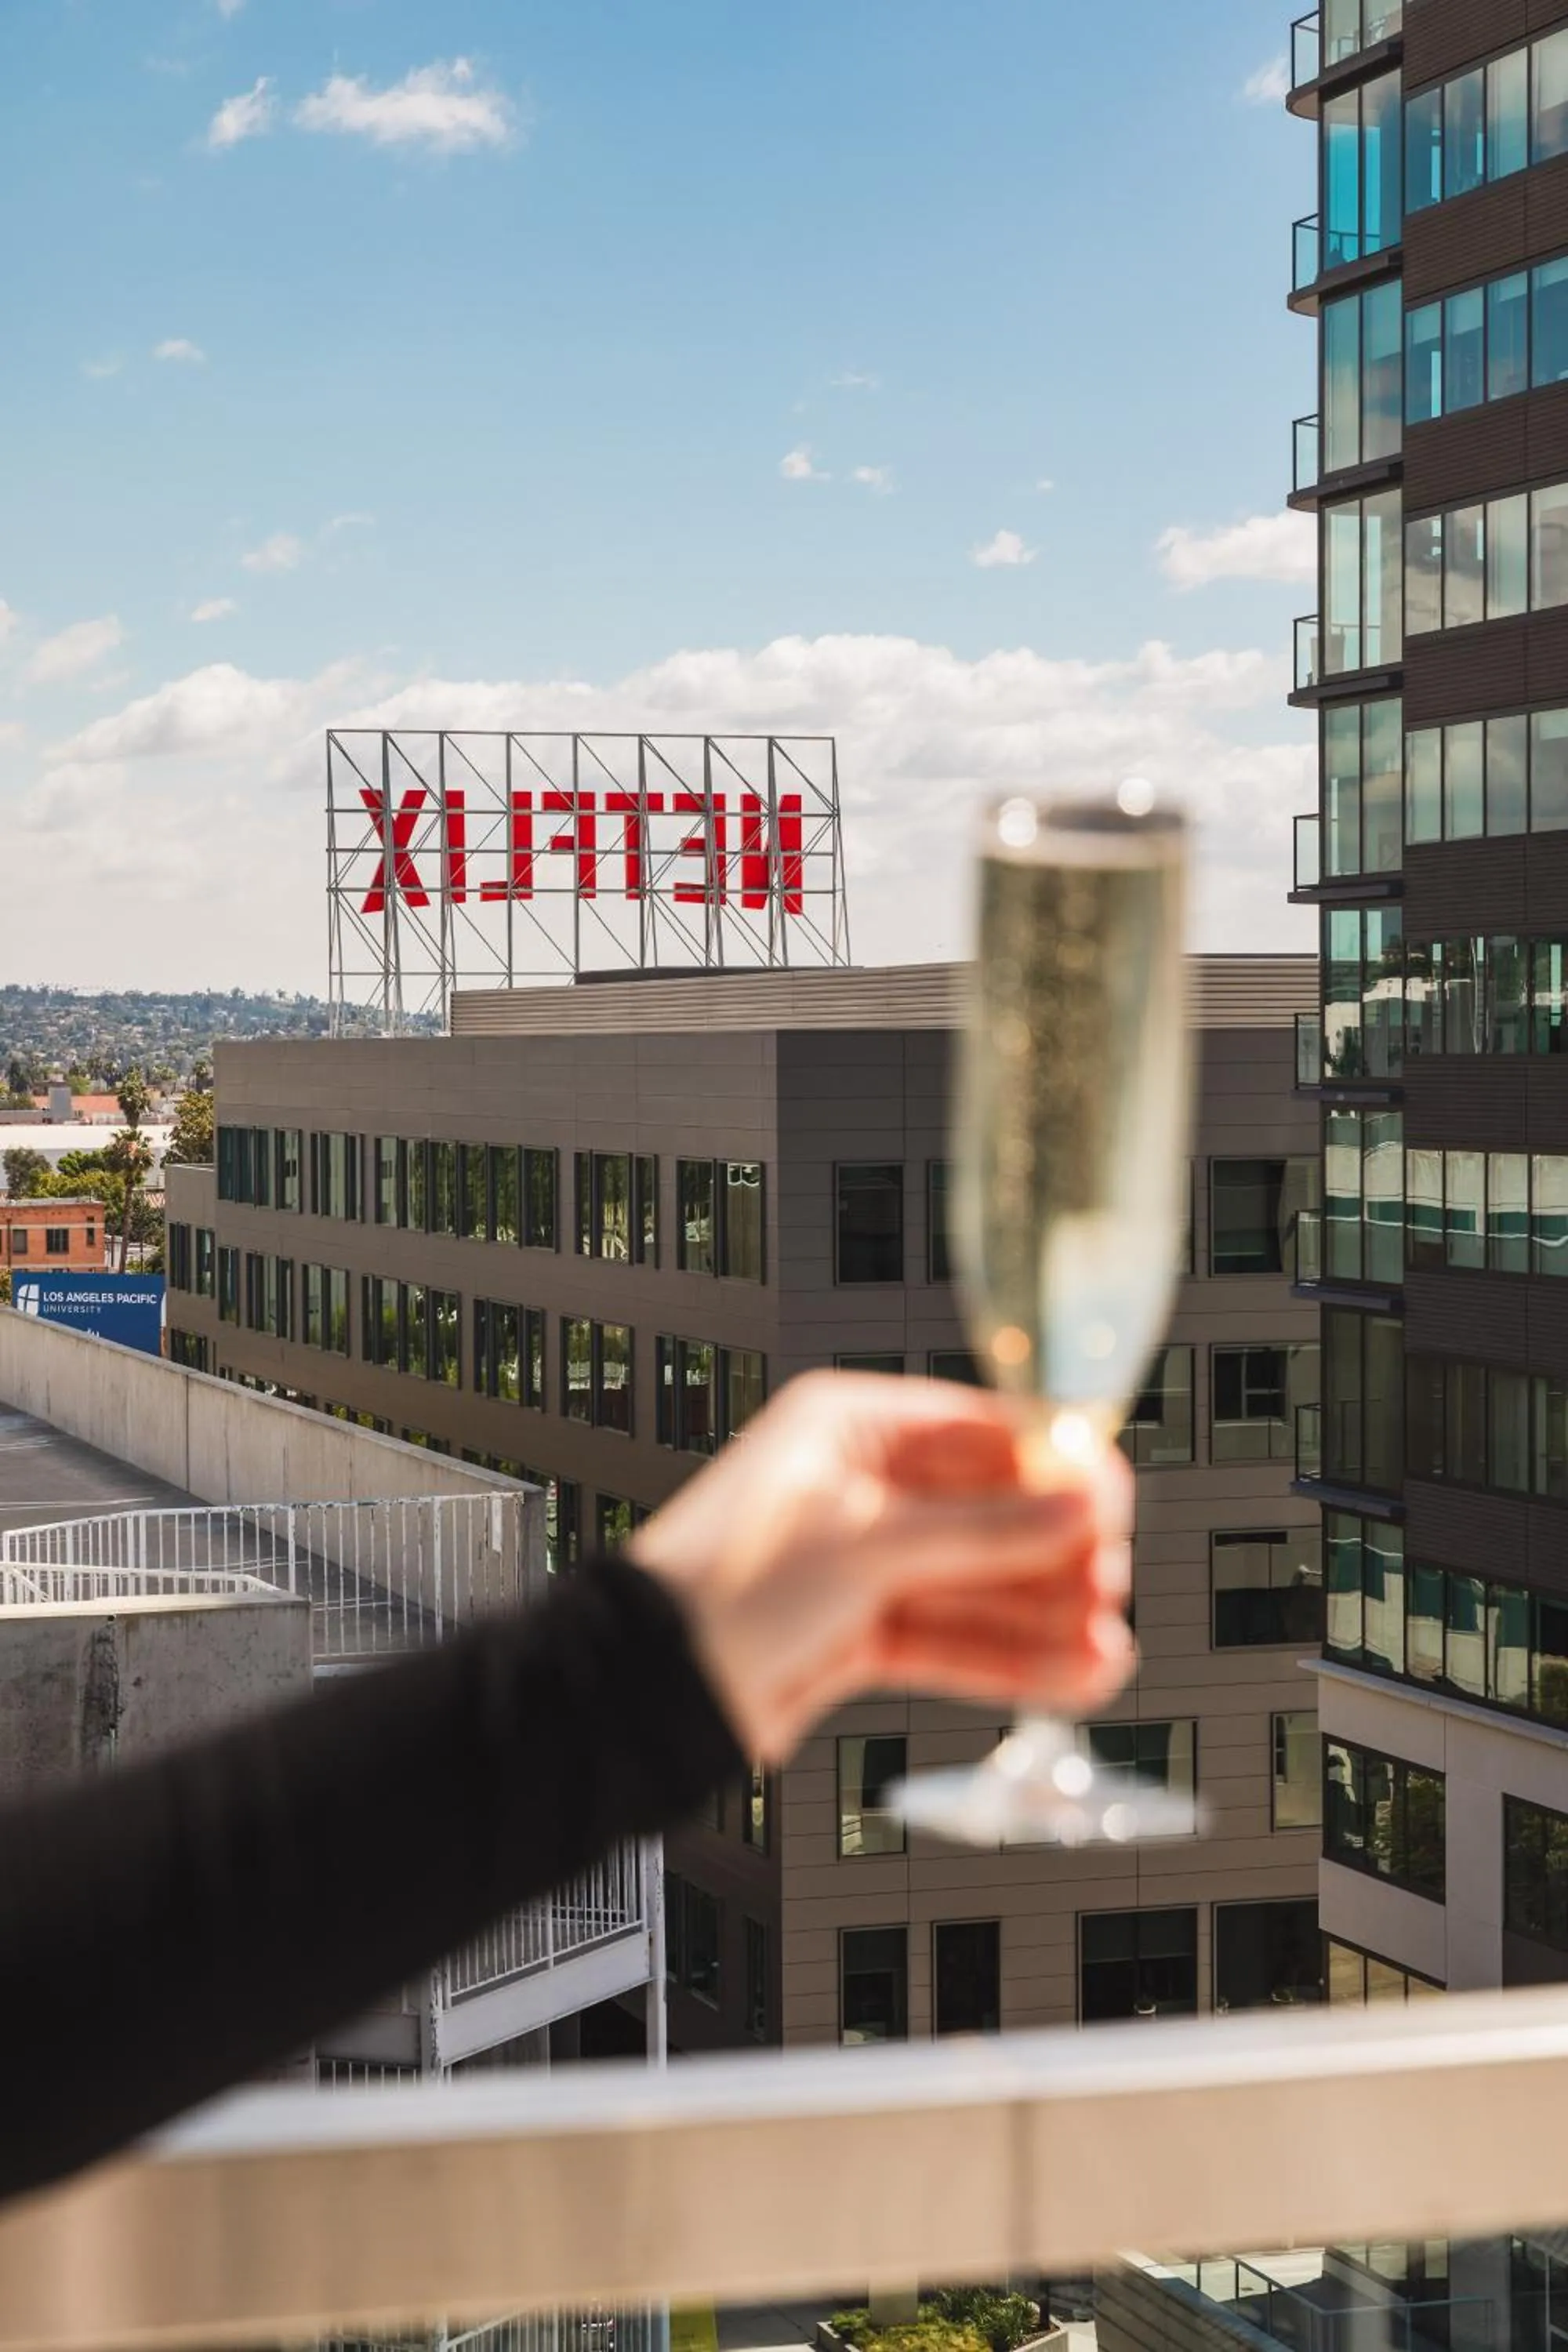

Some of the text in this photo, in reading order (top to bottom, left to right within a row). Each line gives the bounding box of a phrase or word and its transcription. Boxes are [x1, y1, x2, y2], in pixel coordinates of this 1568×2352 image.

[43, 1292, 158, 1304] LOS ANGELES PACIFIC
[43, 1305, 102, 1313] UNIVERSITY
